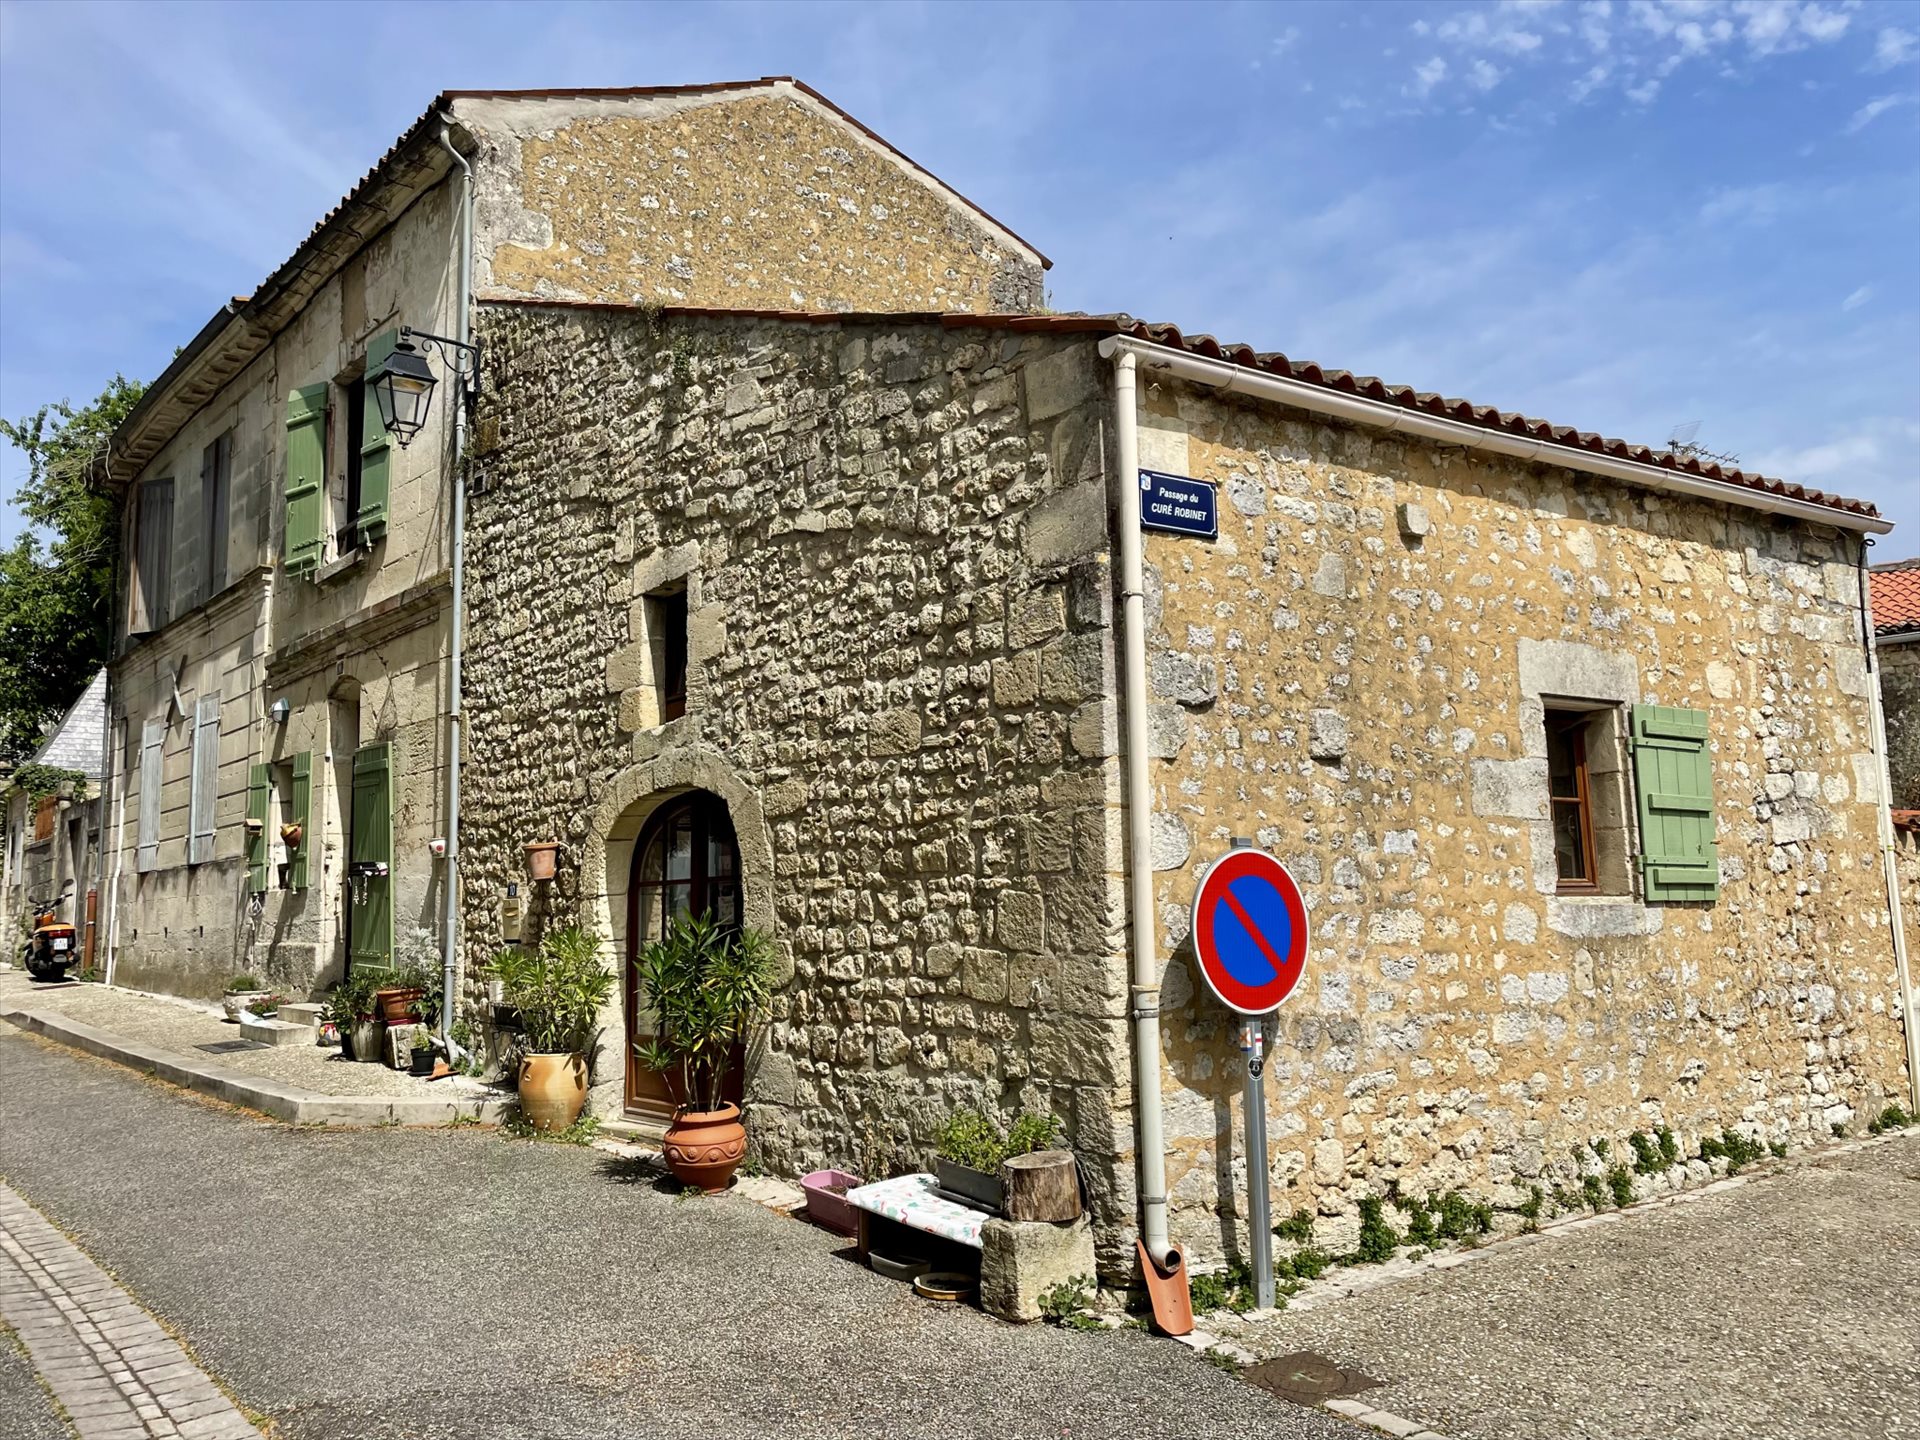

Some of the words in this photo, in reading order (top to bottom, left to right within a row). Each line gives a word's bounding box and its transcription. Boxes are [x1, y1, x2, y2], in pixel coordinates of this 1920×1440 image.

[1159, 487, 1188, 503] Passage
[1190, 493, 1199, 503] du
[1151, 503, 1172, 515] CURÉ
[1174, 506, 1207, 521] ROBINET
